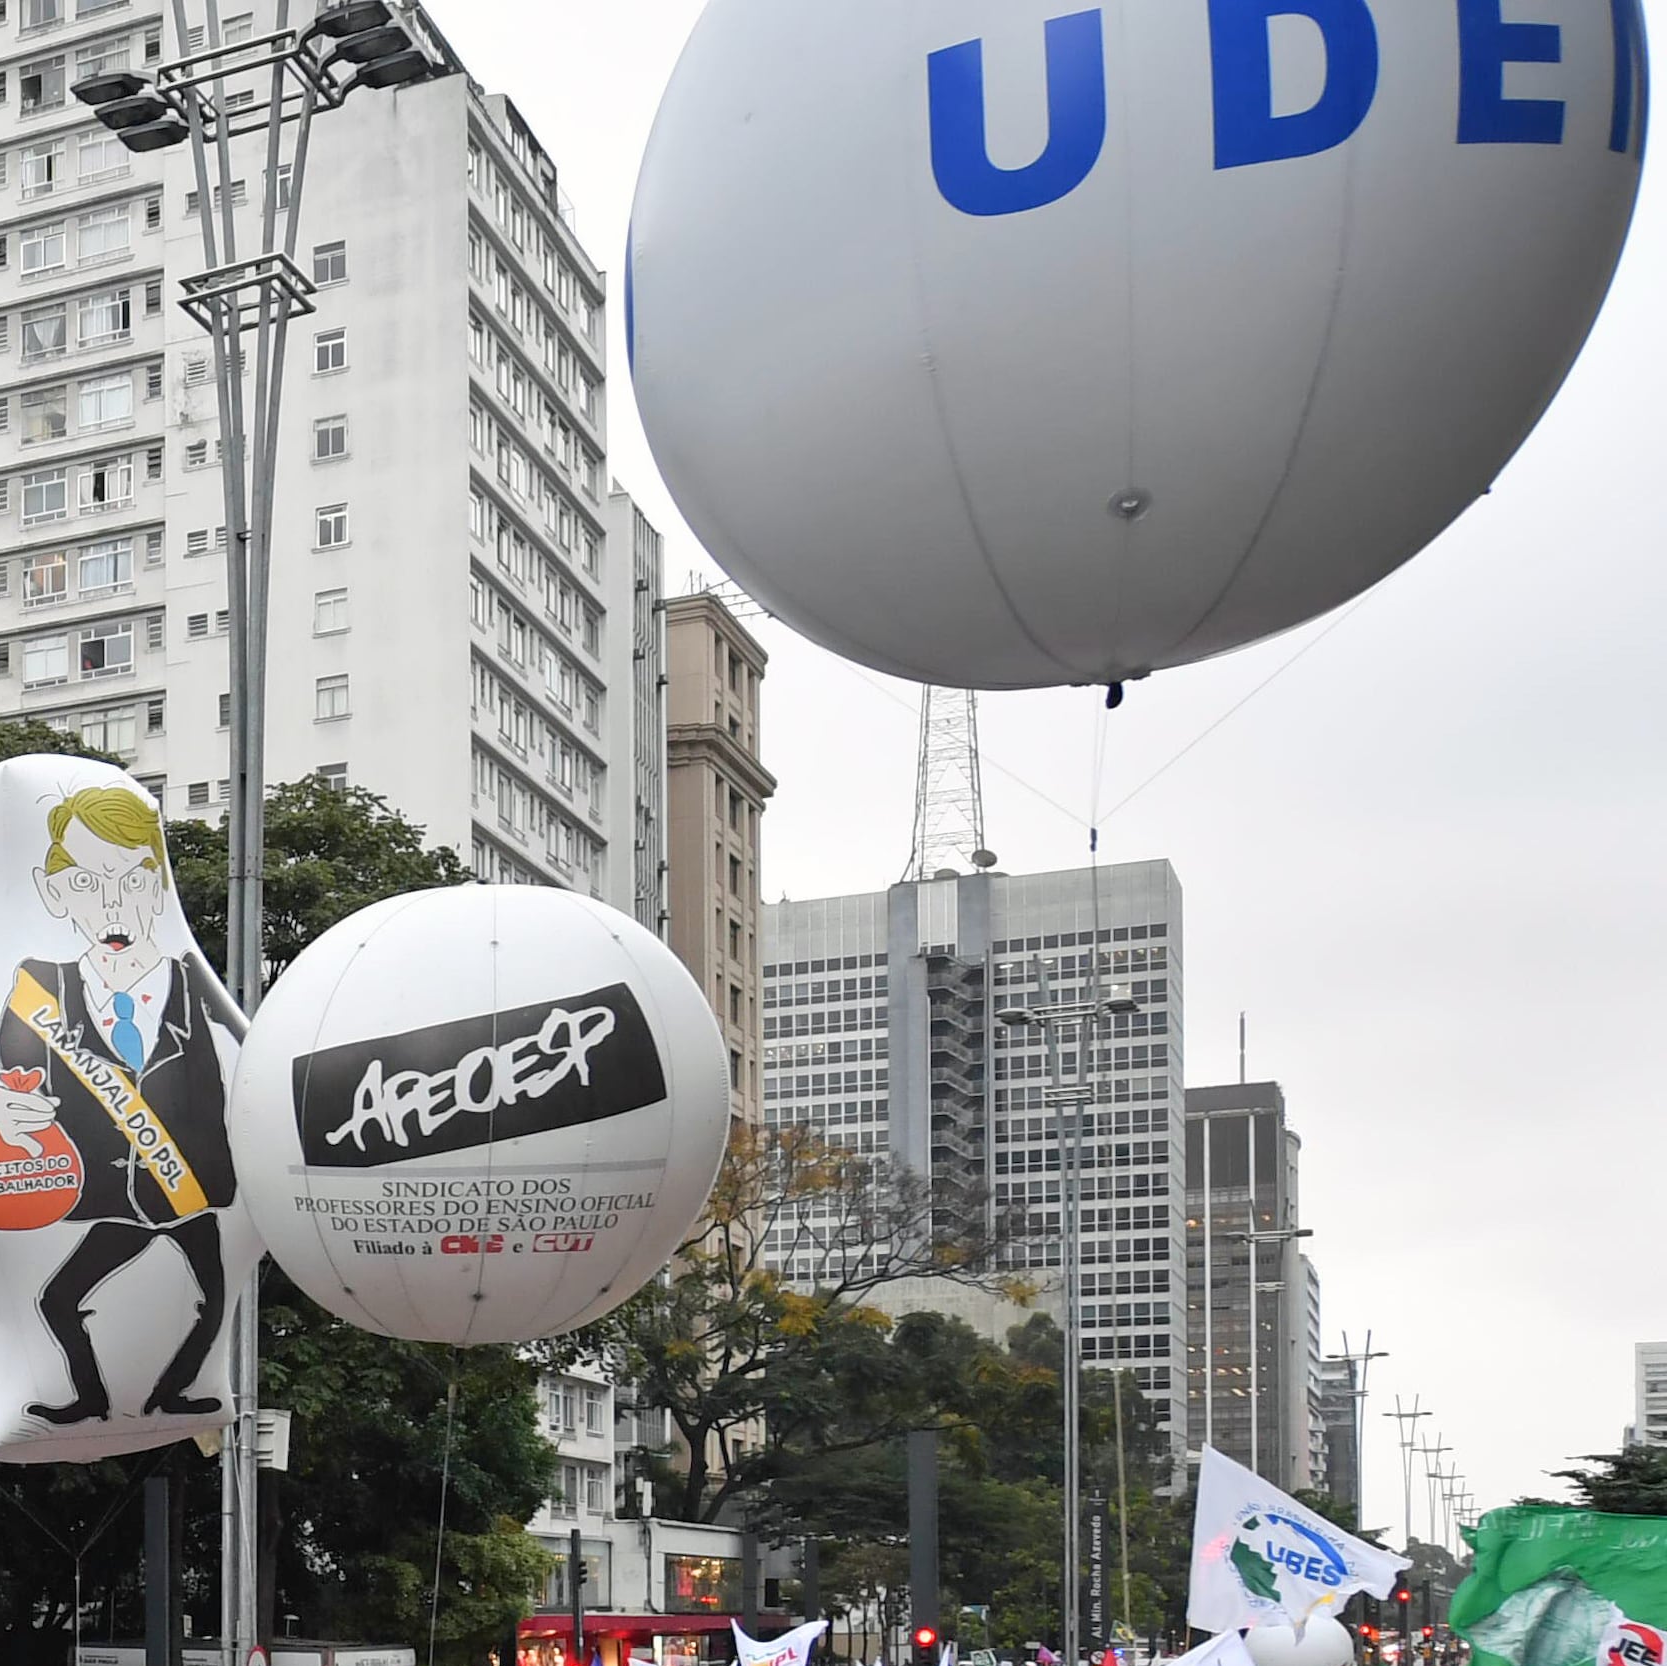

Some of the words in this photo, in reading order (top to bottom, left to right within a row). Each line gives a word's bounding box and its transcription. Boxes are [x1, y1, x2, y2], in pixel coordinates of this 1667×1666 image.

[927, 0, 1639, 217] UDE
[326, 1006, 615, 1151] APEOESP
[32, 1007, 132, 1115] LARANJAL
[127, 1112, 157, 1147] DO
[152, 1145, 185, 1190] PSL
[47, 1156, 70, 1169] DO
[295, 1197, 435, 1216] PROFESSORES
[443, 1200, 479, 1216] DO
[486, 1198, 576, 1215] ENSINO
[581, 1193, 656, 1212] OFICIAL
[382, 1179, 515, 1198] SINDICATO
[522, 1178, 571, 1195] DOS
[331, 1217, 360, 1232] DO
[363, 1217, 452, 1234] ESTADO
[458, 1216, 490, 1233] DE
[497, 1213, 546, 1232] SÃO
[552, 1213, 619, 1231] PAULO
[353, 1239, 415, 1256] Filiado
[422, 1240, 433, 1255] à
[513, 1243, 524, 1254] e
[533, 1233, 595, 1252] CUT
[1090, 1515, 1103, 1560] Azevedo
[1090, 1563, 1103, 1597] Rocha
[1267, 1540, 1342, 1586] UBES
